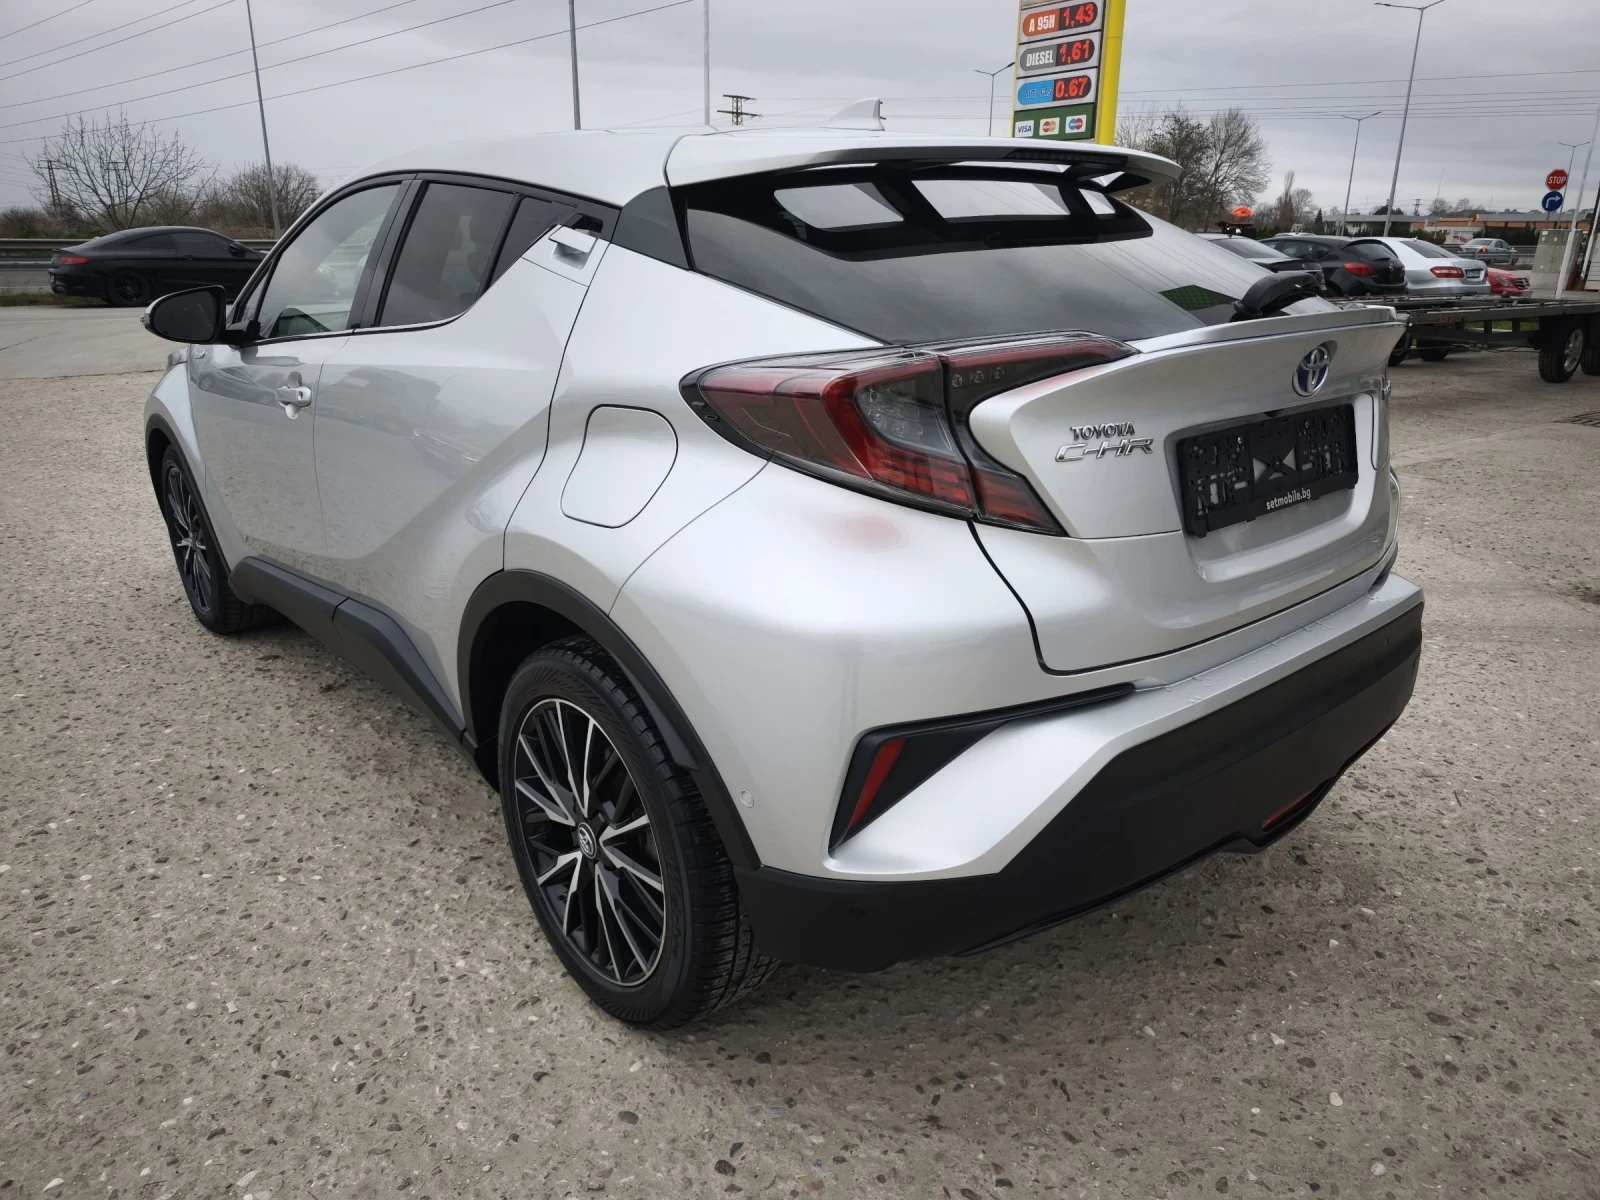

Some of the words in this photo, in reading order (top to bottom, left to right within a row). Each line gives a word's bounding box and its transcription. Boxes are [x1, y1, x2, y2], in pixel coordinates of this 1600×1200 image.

[1026, 50, 1053, 66] DIESEL
[1055, 78, 1087, 98] 0.67
[1017, 125, 1032, 133] VISA
[1548, 176, 1566, 184] STOP
[1070, 421, 1136, 441] TOYOTA
[1055, 437, 1154, 462] C-HR
[1266, 487, 1312, 510] setmobile.bg
